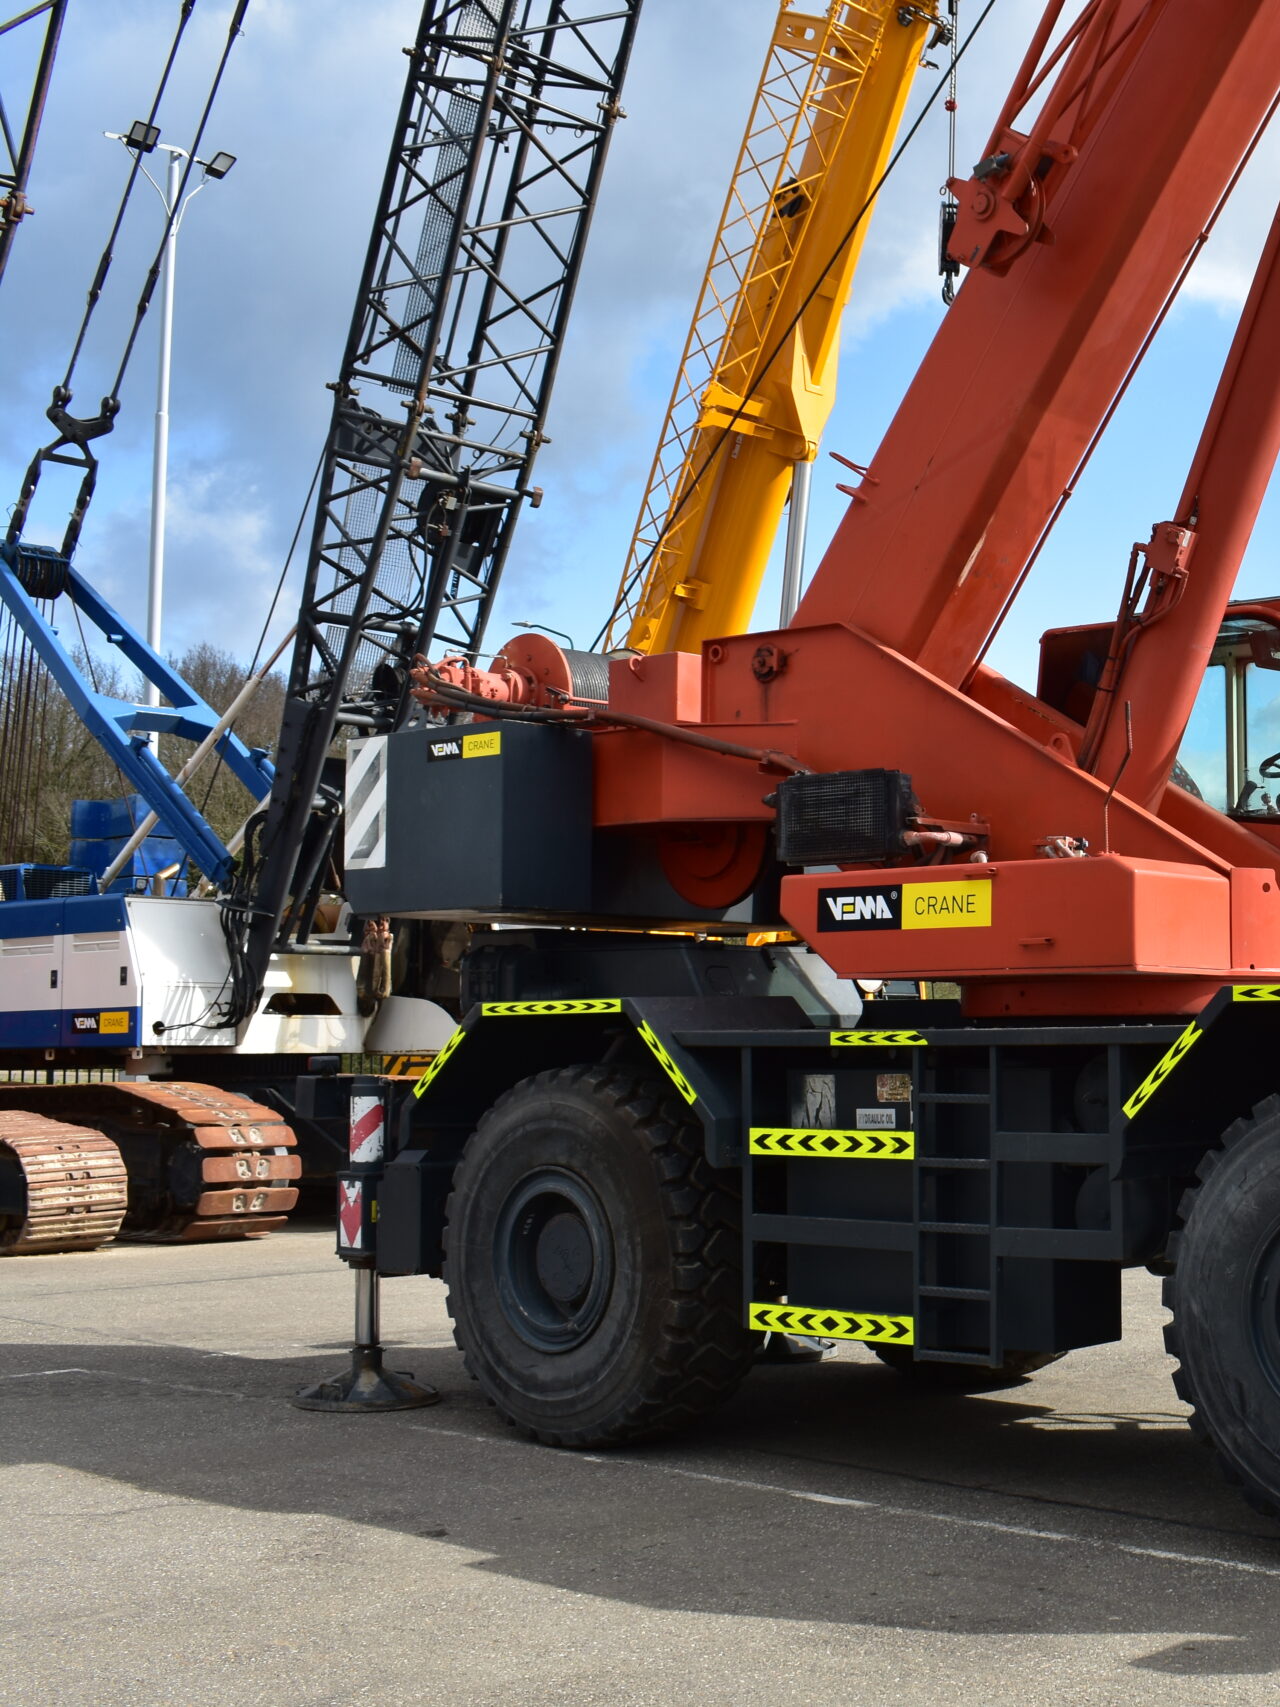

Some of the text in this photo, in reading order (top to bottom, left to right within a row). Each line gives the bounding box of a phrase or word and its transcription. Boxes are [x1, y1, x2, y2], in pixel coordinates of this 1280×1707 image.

[467, 738, 495, 752] CRANE
[914, 894, 976, 915] CRANE
[103, 1017, 124, 1028] CRANE
[886, 1113, 894, 1125] OIL
